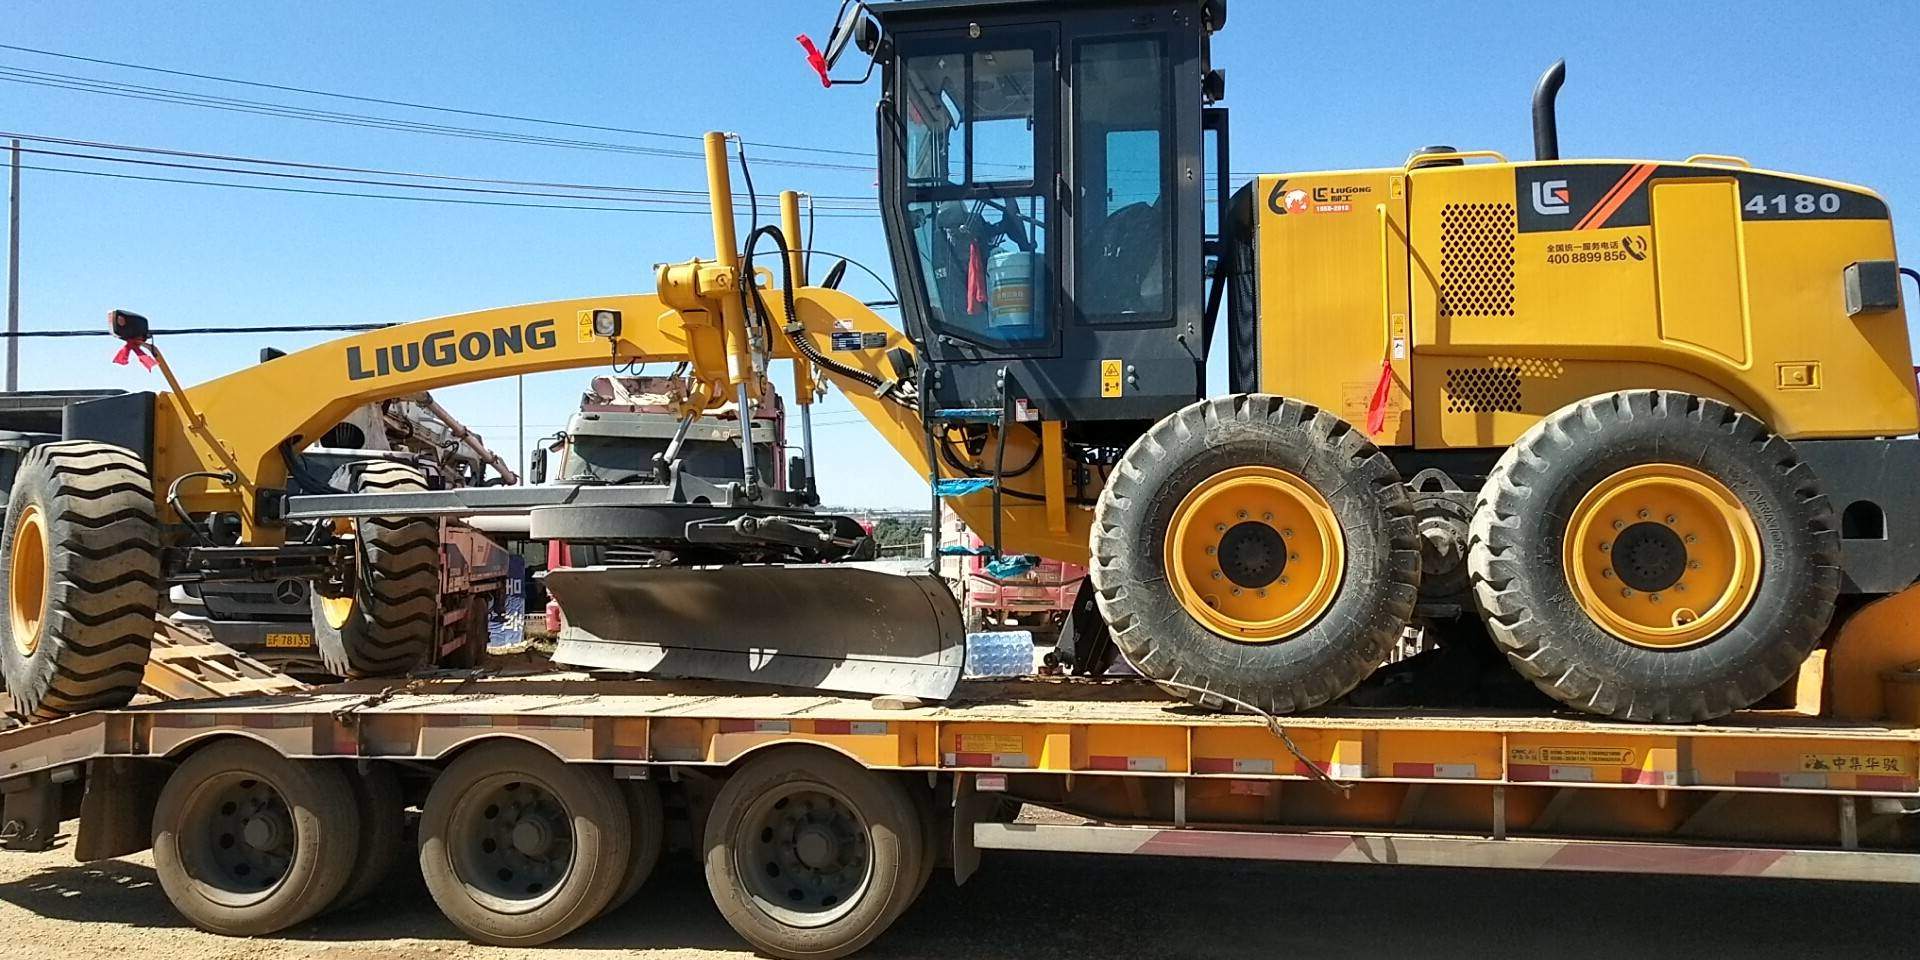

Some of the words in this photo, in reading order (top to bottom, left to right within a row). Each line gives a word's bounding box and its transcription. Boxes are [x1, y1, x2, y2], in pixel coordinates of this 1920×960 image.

[1744, 193, 1841, 214] 4180
[1547, 241, 1619, 253] 全国统一服务电话
[1547, 253, 1570, 265] 400
[1571, 252, 1602, 264] 8899
[1603, 250, 1627, 262] 856
[1832, 756, 1900, 772] 中集华骏
